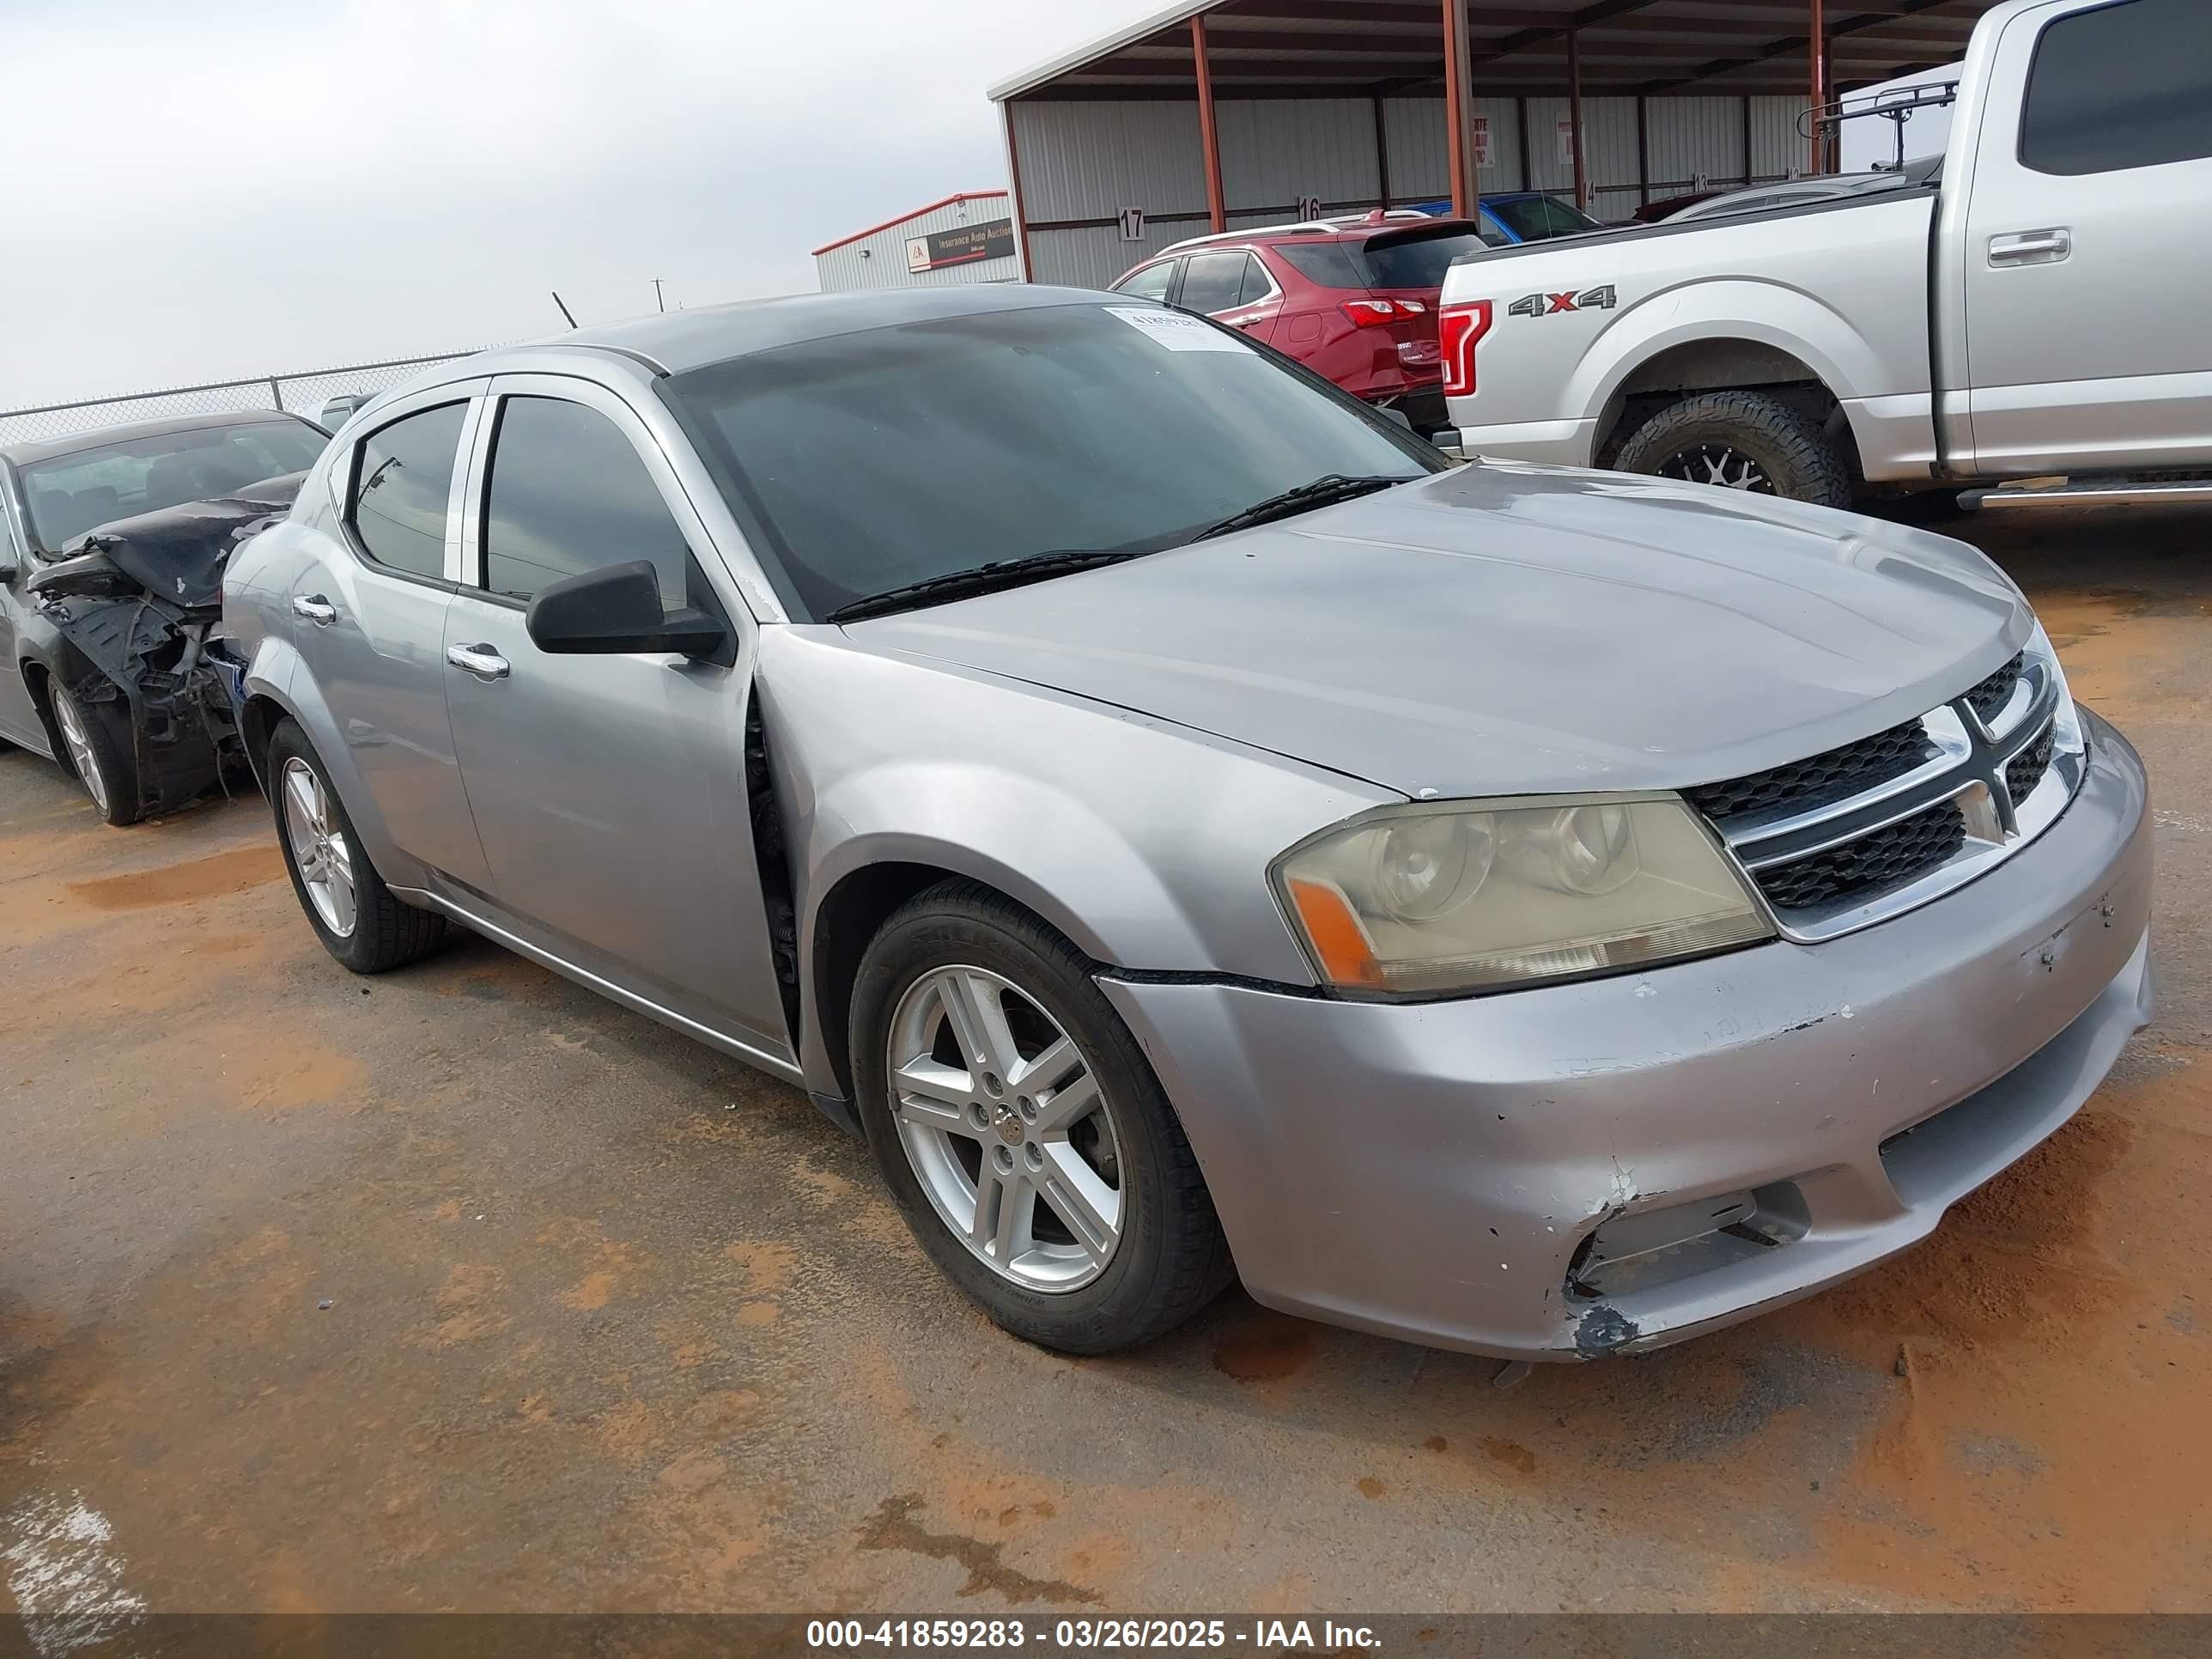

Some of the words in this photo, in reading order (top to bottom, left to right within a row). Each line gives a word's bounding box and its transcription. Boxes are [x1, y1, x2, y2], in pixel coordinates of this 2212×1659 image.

[1300, 198, 1319, 222] 16
[1121, 210, 1142, 238] 17
[939, 234, 969, 249] Insurance
[970, 231, 986, 242] Auto
